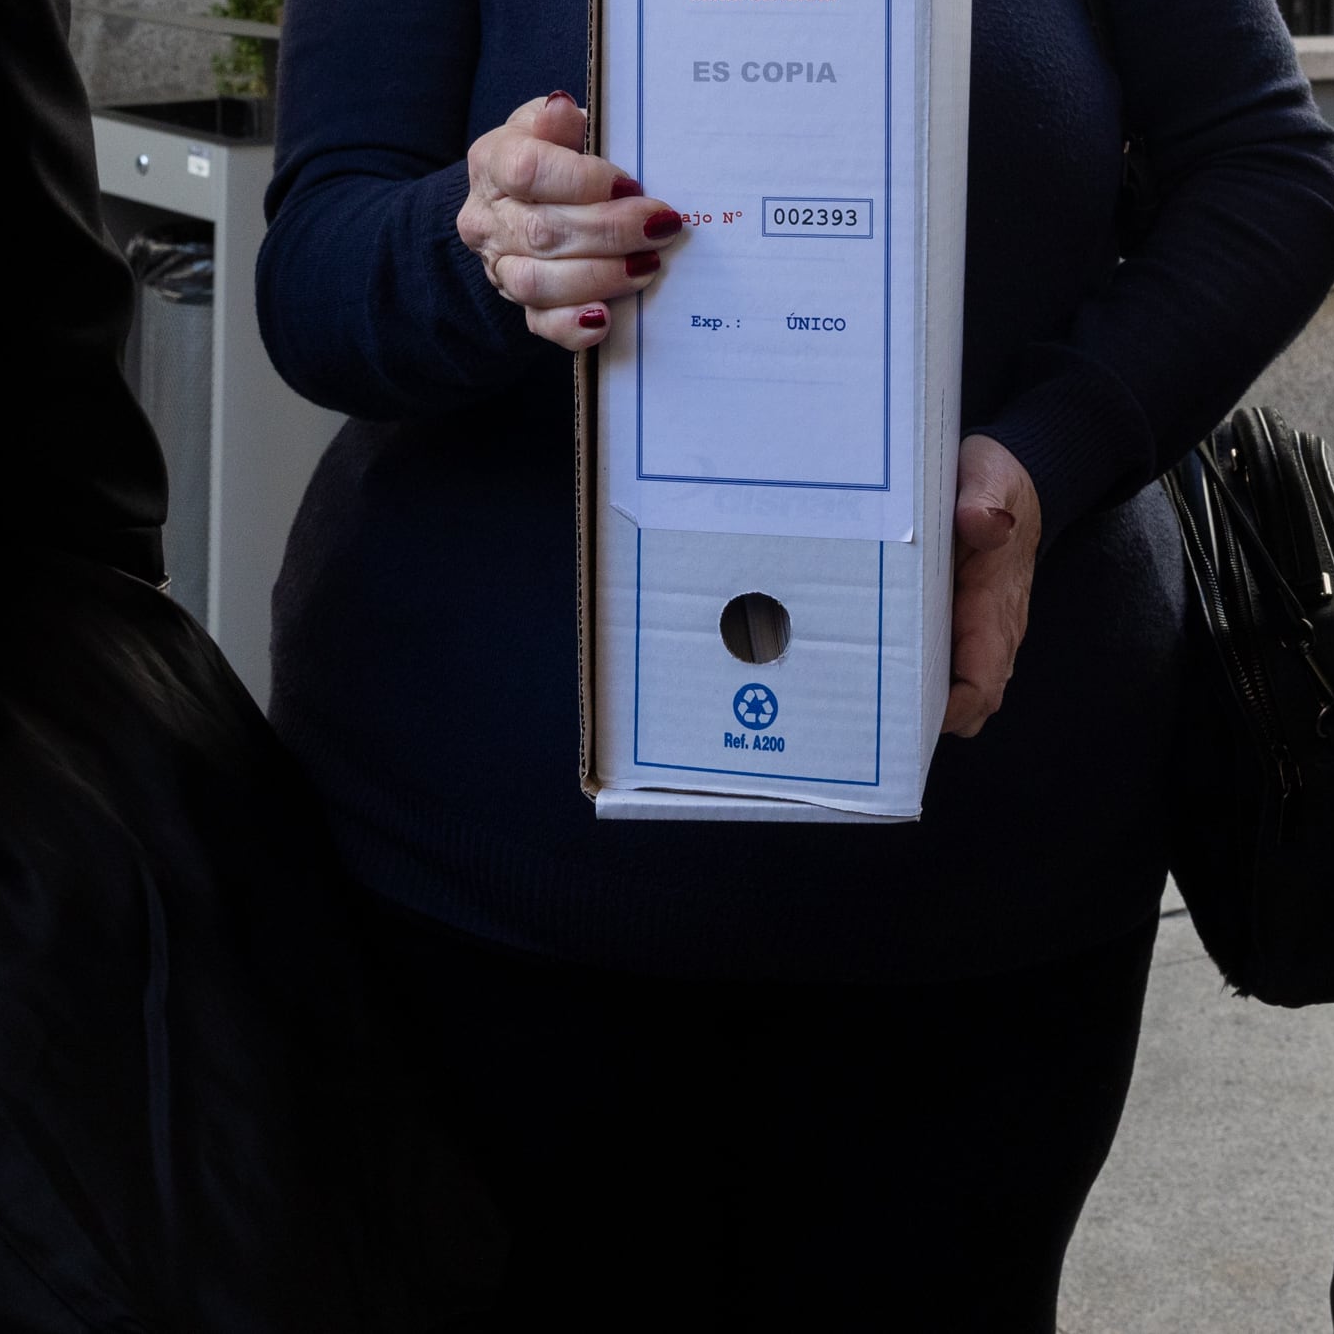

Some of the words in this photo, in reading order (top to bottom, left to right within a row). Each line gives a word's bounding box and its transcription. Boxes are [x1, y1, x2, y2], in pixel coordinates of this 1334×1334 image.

[692, 61, 730, 83] ES
[741, 61, 838, 84] COPIA
[773, 207, 858, 227] 002393
[786, 312, 847, 332] ÚNICO
[723, 731, 749, 750] Ref.
[752, 734, 786, 753] A200
